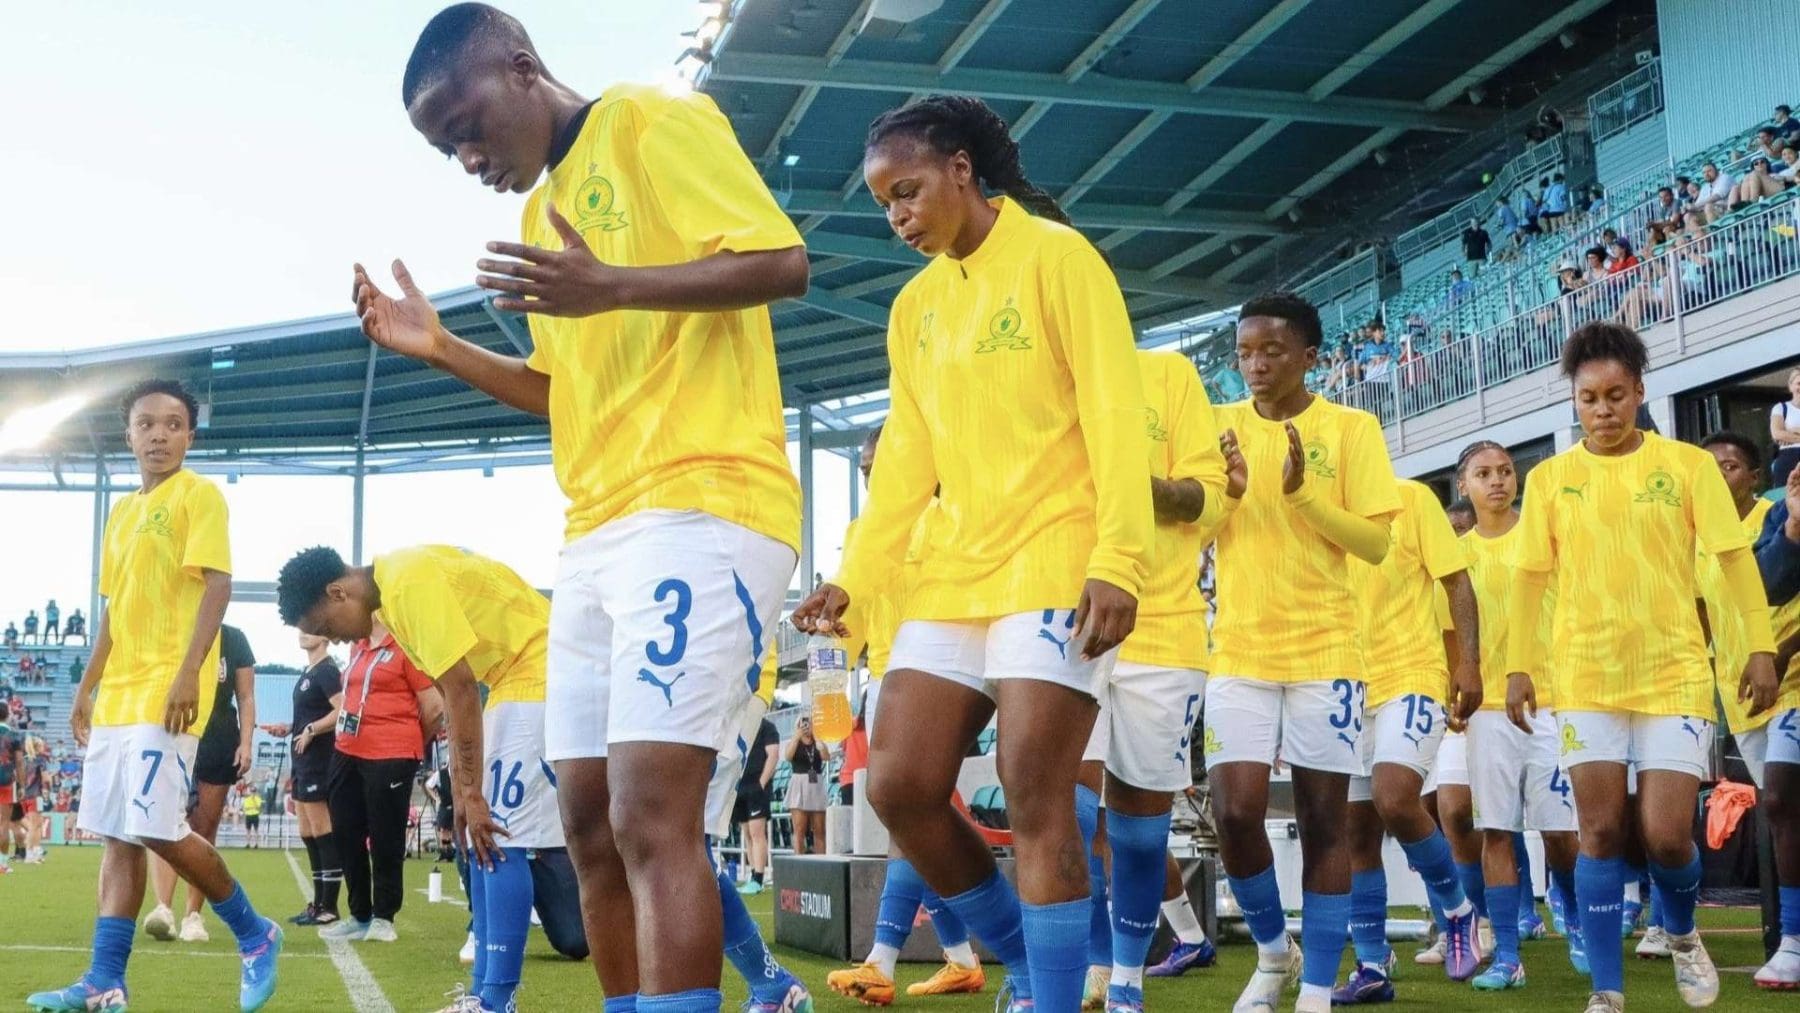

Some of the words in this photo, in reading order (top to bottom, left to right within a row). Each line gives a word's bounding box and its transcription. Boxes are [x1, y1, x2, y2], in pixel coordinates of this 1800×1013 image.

[646, 579, 692, 666] 3
[1329, 678, 1364, 732] 33
[1401, 694, 1435, 734] 15
[141, 750, 163, 796] 7
[490, 759, 524, 808] 16
[1550, 764, 1570, 798] 4
[1589, 903, 1622, 913] MSFC
